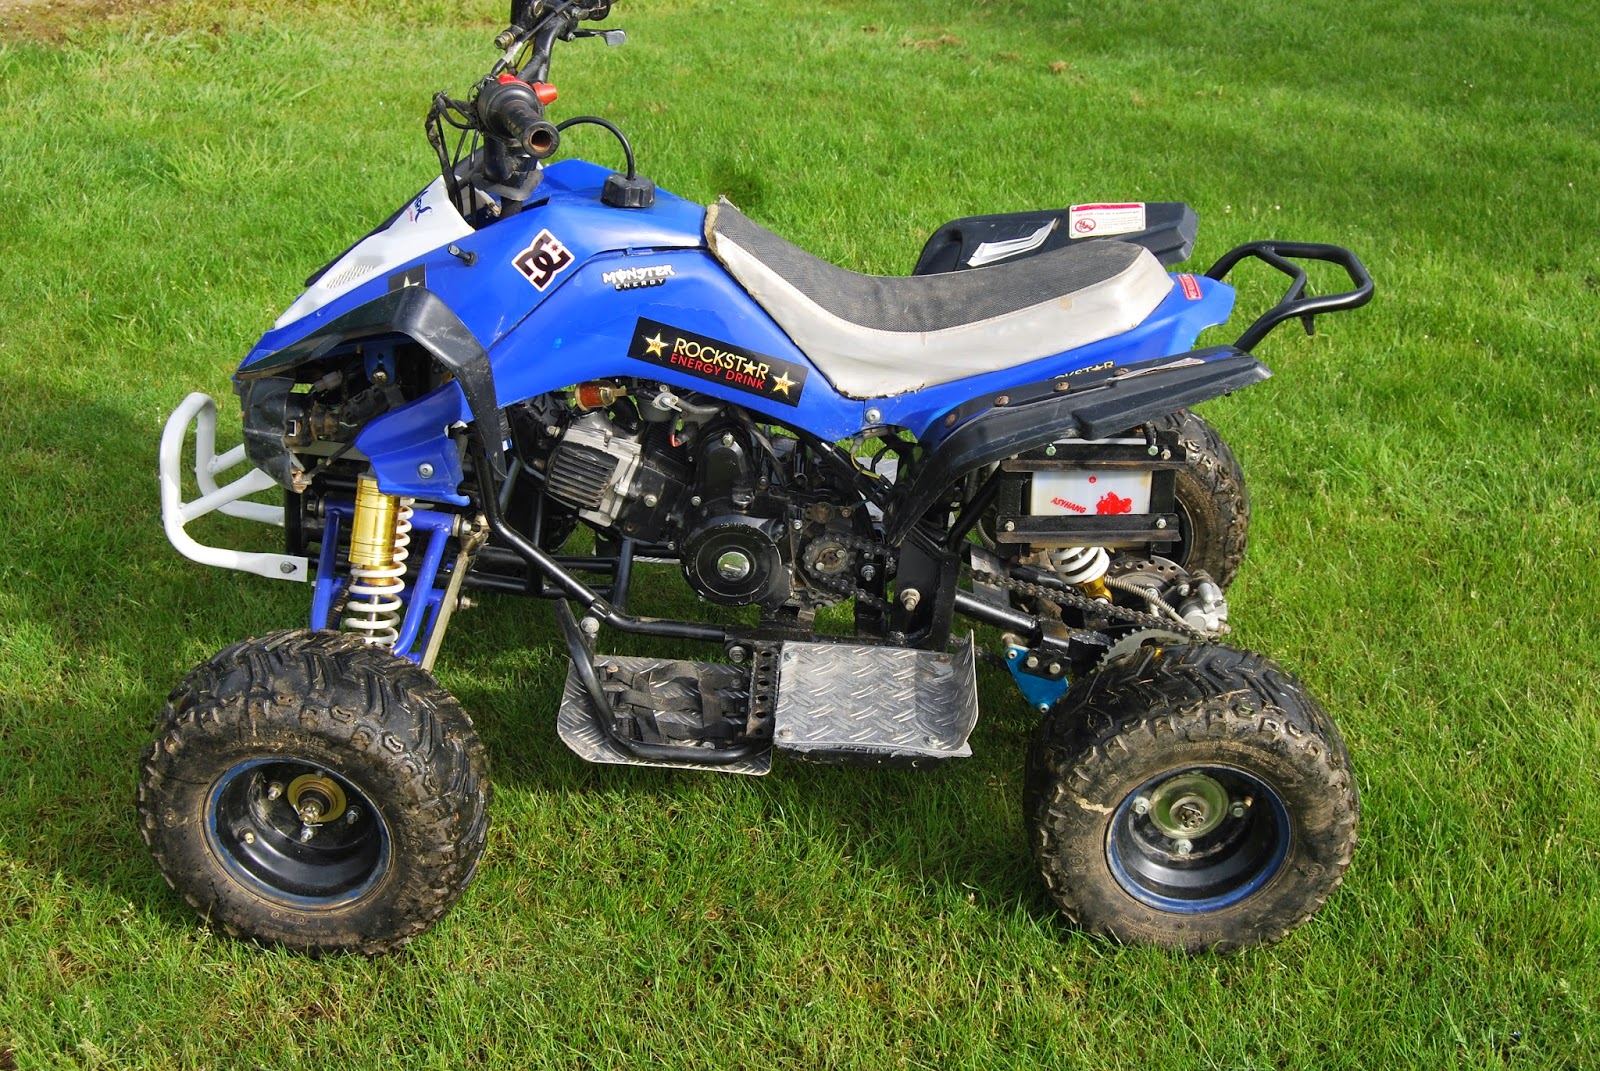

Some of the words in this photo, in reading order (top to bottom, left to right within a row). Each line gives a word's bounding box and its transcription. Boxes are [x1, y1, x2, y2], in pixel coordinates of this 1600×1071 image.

[602, 264, 676, 285] MONSTER
[614, 278, 665, 290] ENERGY
[670, 353, 722, 377] ENERGY
[725, 370, 766, 390] DRINK
